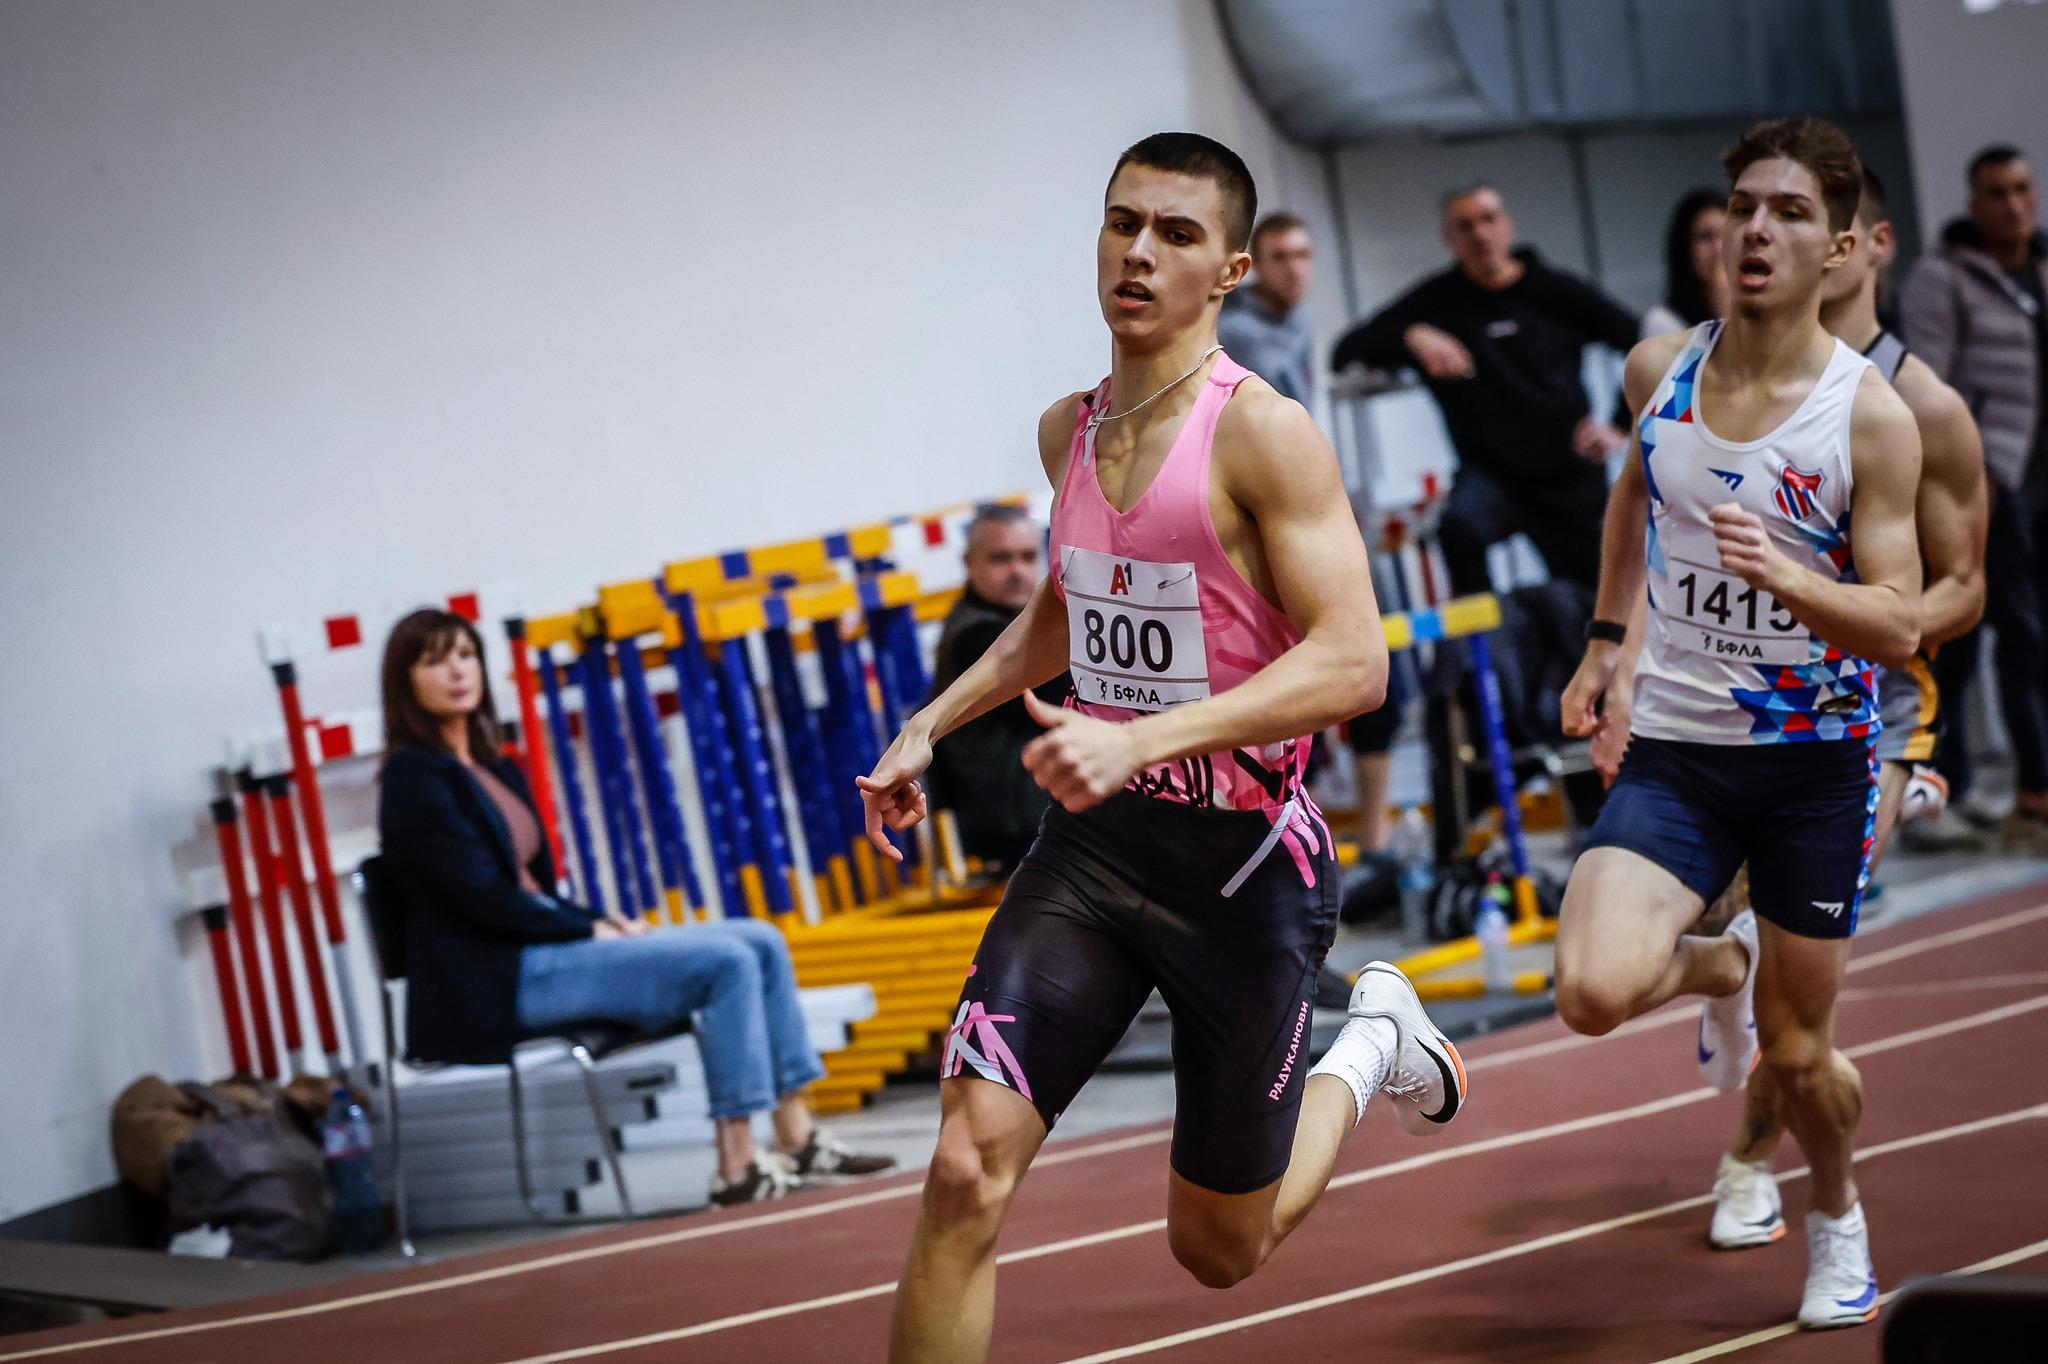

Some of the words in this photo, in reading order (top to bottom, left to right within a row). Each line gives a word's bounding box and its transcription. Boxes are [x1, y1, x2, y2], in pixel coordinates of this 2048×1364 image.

[1677, 572, 1800, 631] 1415
[1084, 608, 1173, 673] 800
[1716, 640, 1763, 659] БФЛА
[1113, 684, 1162, 705] БФЛА
[1268, 1000, 1309, 1101] РАДУКАНОВИ
